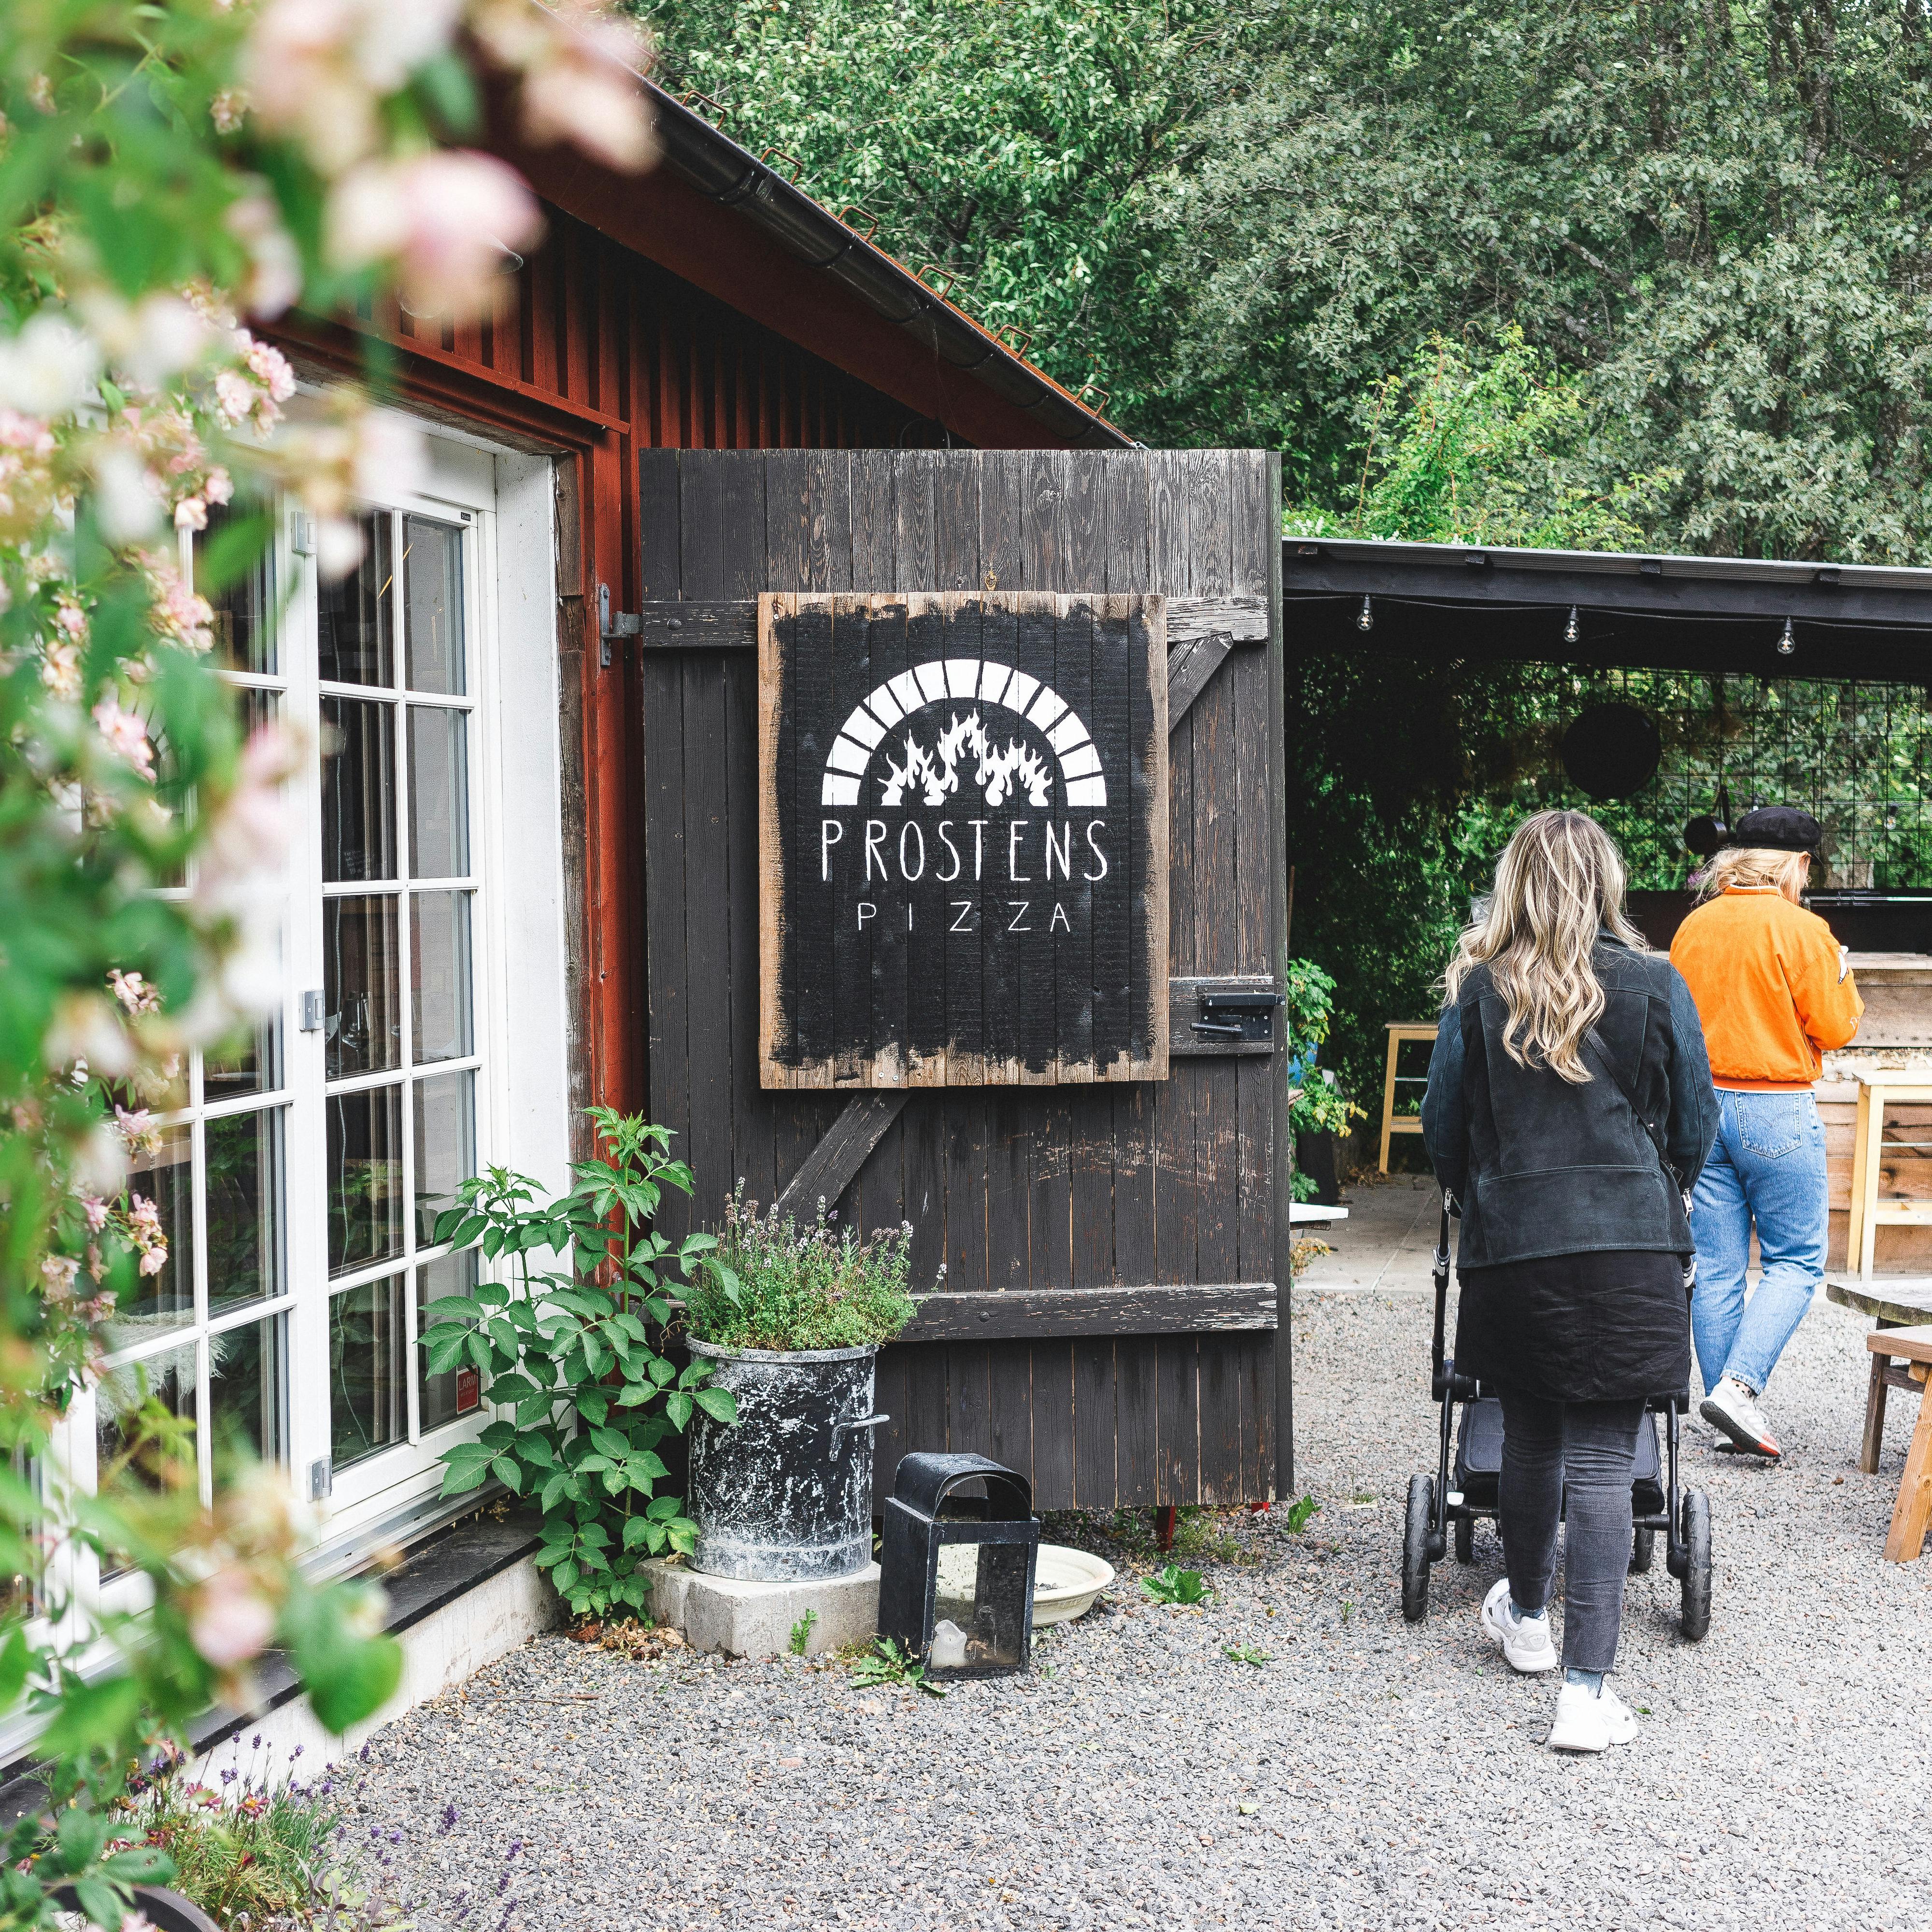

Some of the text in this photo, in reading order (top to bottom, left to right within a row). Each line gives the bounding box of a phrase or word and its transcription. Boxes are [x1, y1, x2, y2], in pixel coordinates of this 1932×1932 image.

[822, 820, 1108, 881] PROSTENS
[857, 901, 1070, 932] PIZZA
[459, 1375, 476, 1391] LARM
